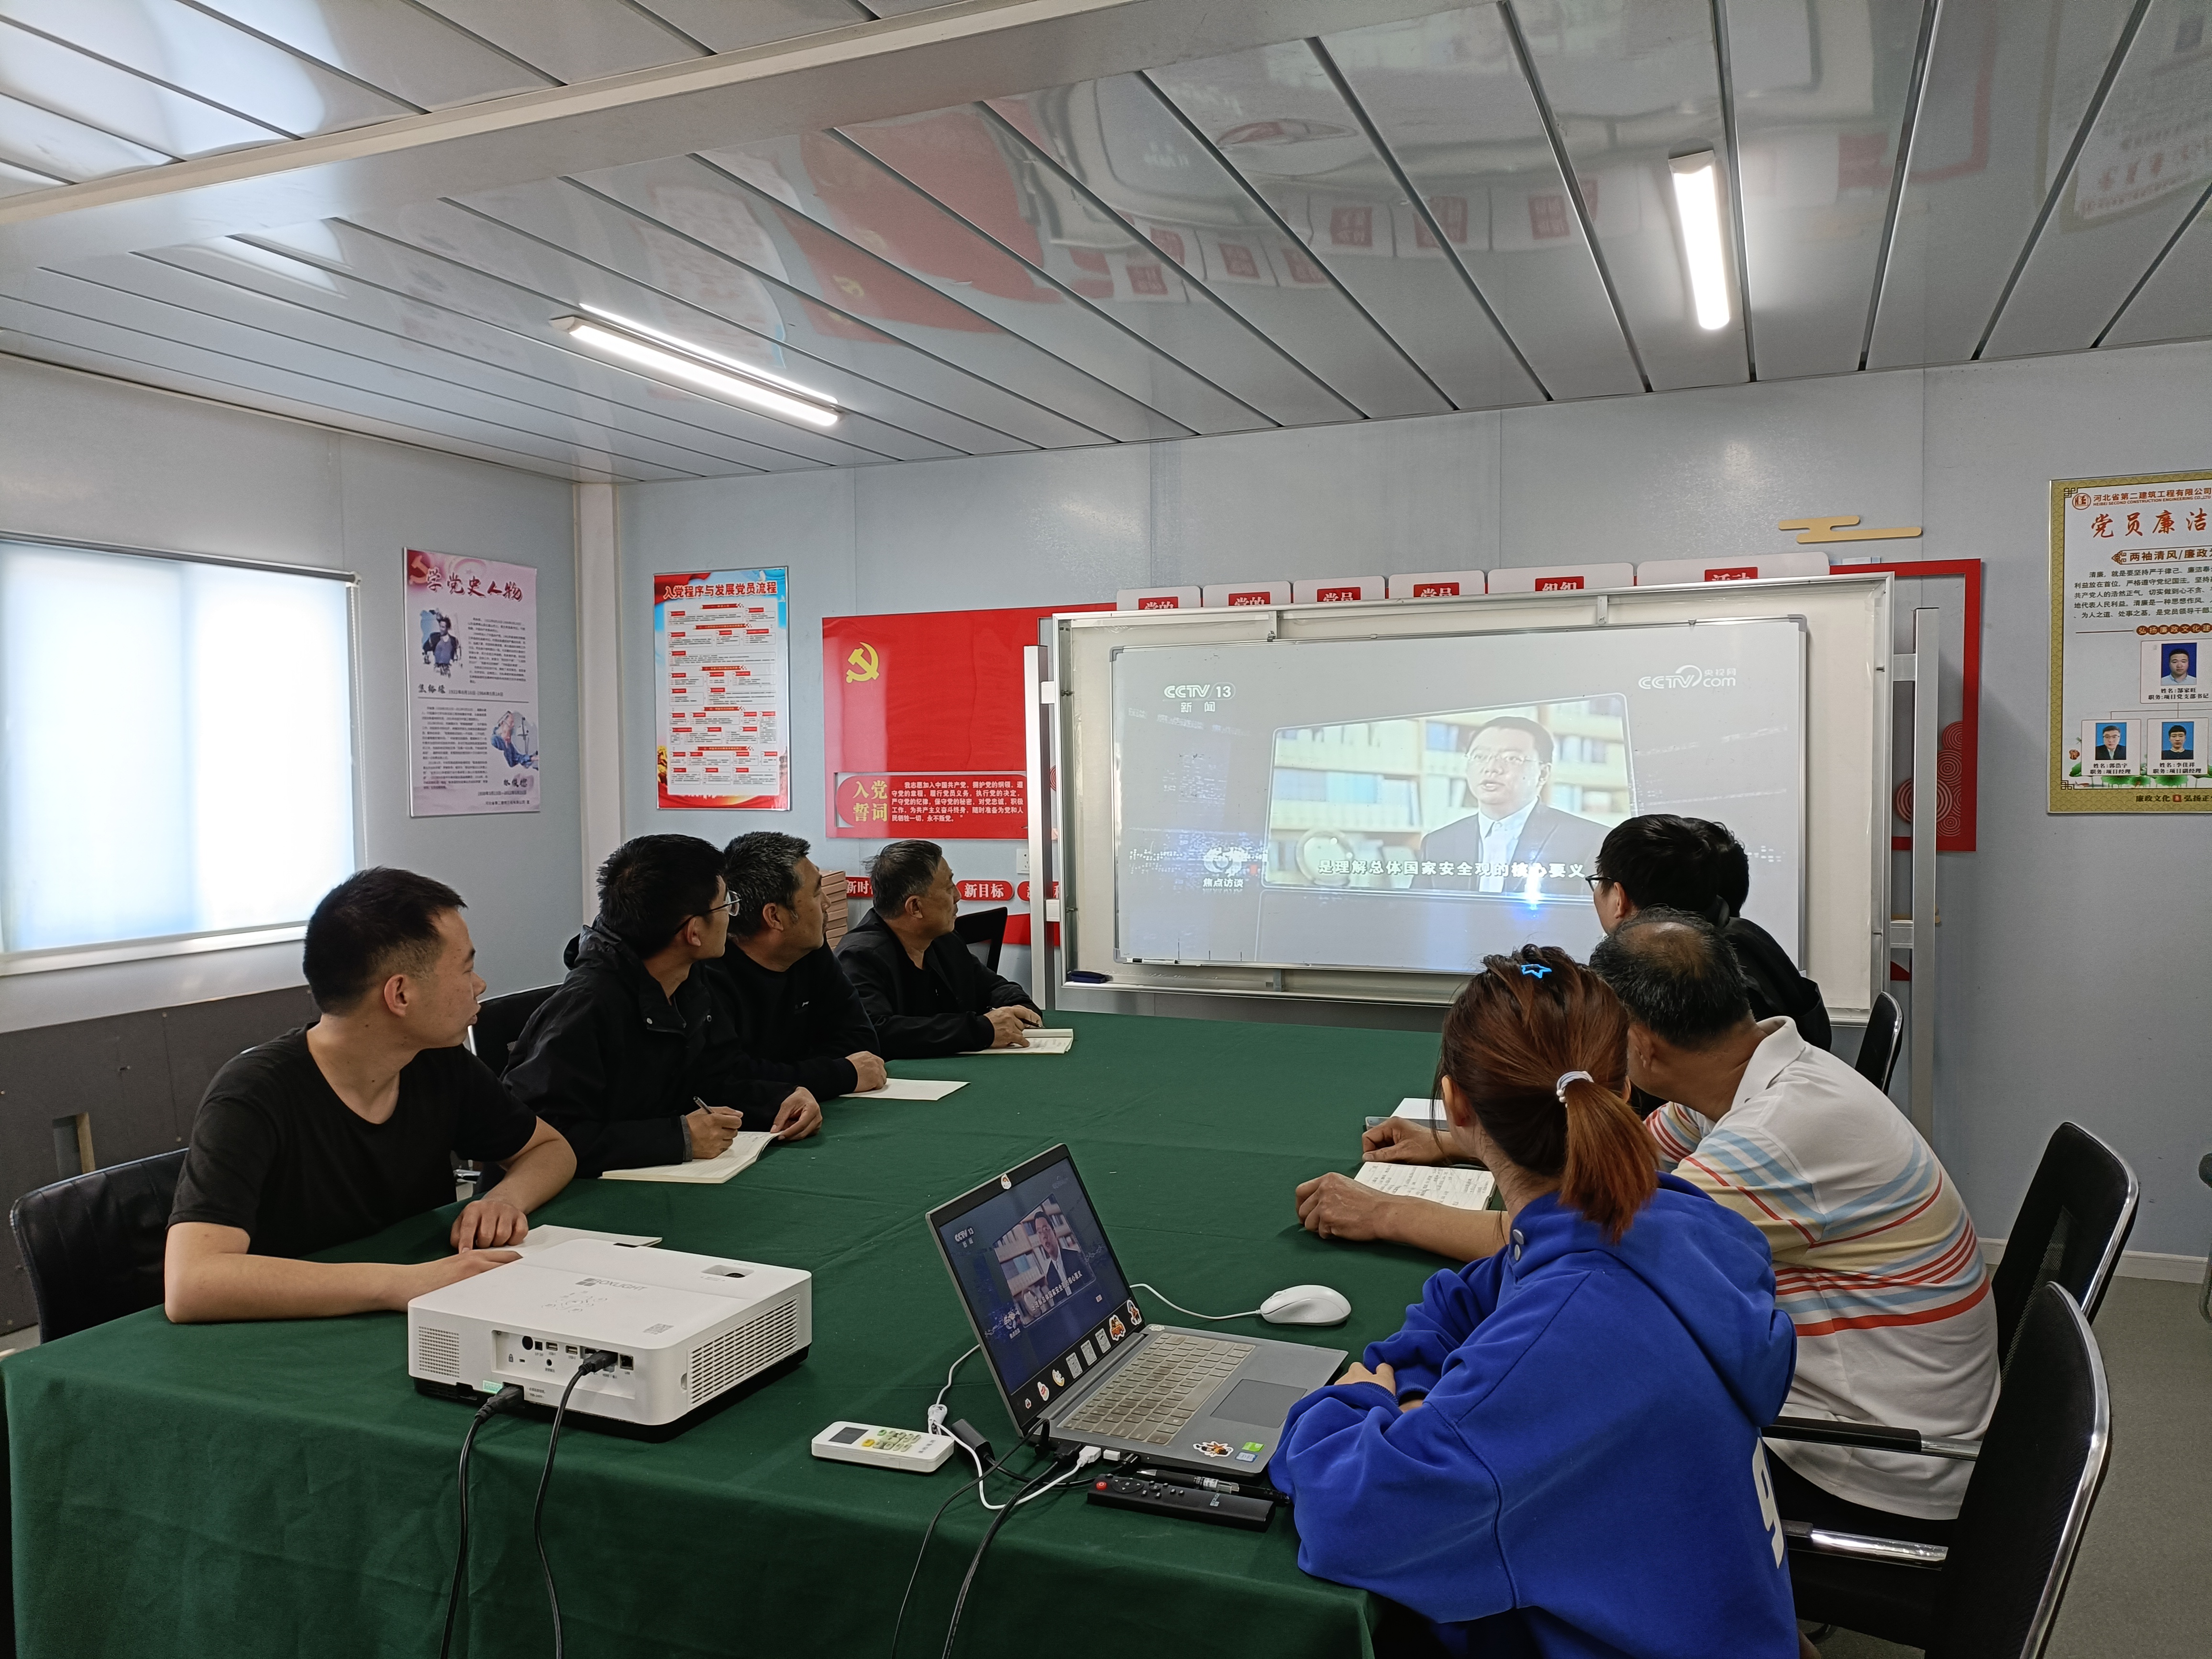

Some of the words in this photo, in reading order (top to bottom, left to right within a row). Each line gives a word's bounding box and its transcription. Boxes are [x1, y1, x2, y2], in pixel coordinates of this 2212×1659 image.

[2093, 487, 2212, 501] 河北省第二建筑工程有限公司
[2091, 508, 2208, 538] 党员廉洁
[2089, 566, 2212, 578] 清廉，就是要坚持严于律己、廉洁奉
[427, 566, 523, 602] 学党史人物
[2074, 576, 2212, 589] 利益放在首位，严格遵守党纪国法。坚持
[663, 581, 777, 599] 入党程序与发展党员流程
[2074, 587, 2212, 599] 共产党人的浩然正气，切实做到心不贪、
[2074, 597, 2212, 609] 地代表人民利益。清廉是一种思想作风、
[2074, 607, 2212, 619] 、为人之道、处事之基，是党员领导干部
[1703, 668, 1736, 677] 央视网
[1638, 670, 1698, 690] CCTV
[1164, 684, 1210, 698] CCTV
[1216, 686, 1231, 698] 13
[1181, 701, 1216, 713] 新闻
[852, 780, 888, 799] 入党
[852, 803, 888, 822] 誓词
[1203, 877, 1244, 889] 焦点访谈
[964, 883, 1004, 898] 新目标
[955, 1229, 968, 1242] CCTV
[593, 1279, 648, 1291] BOXLIGHT
